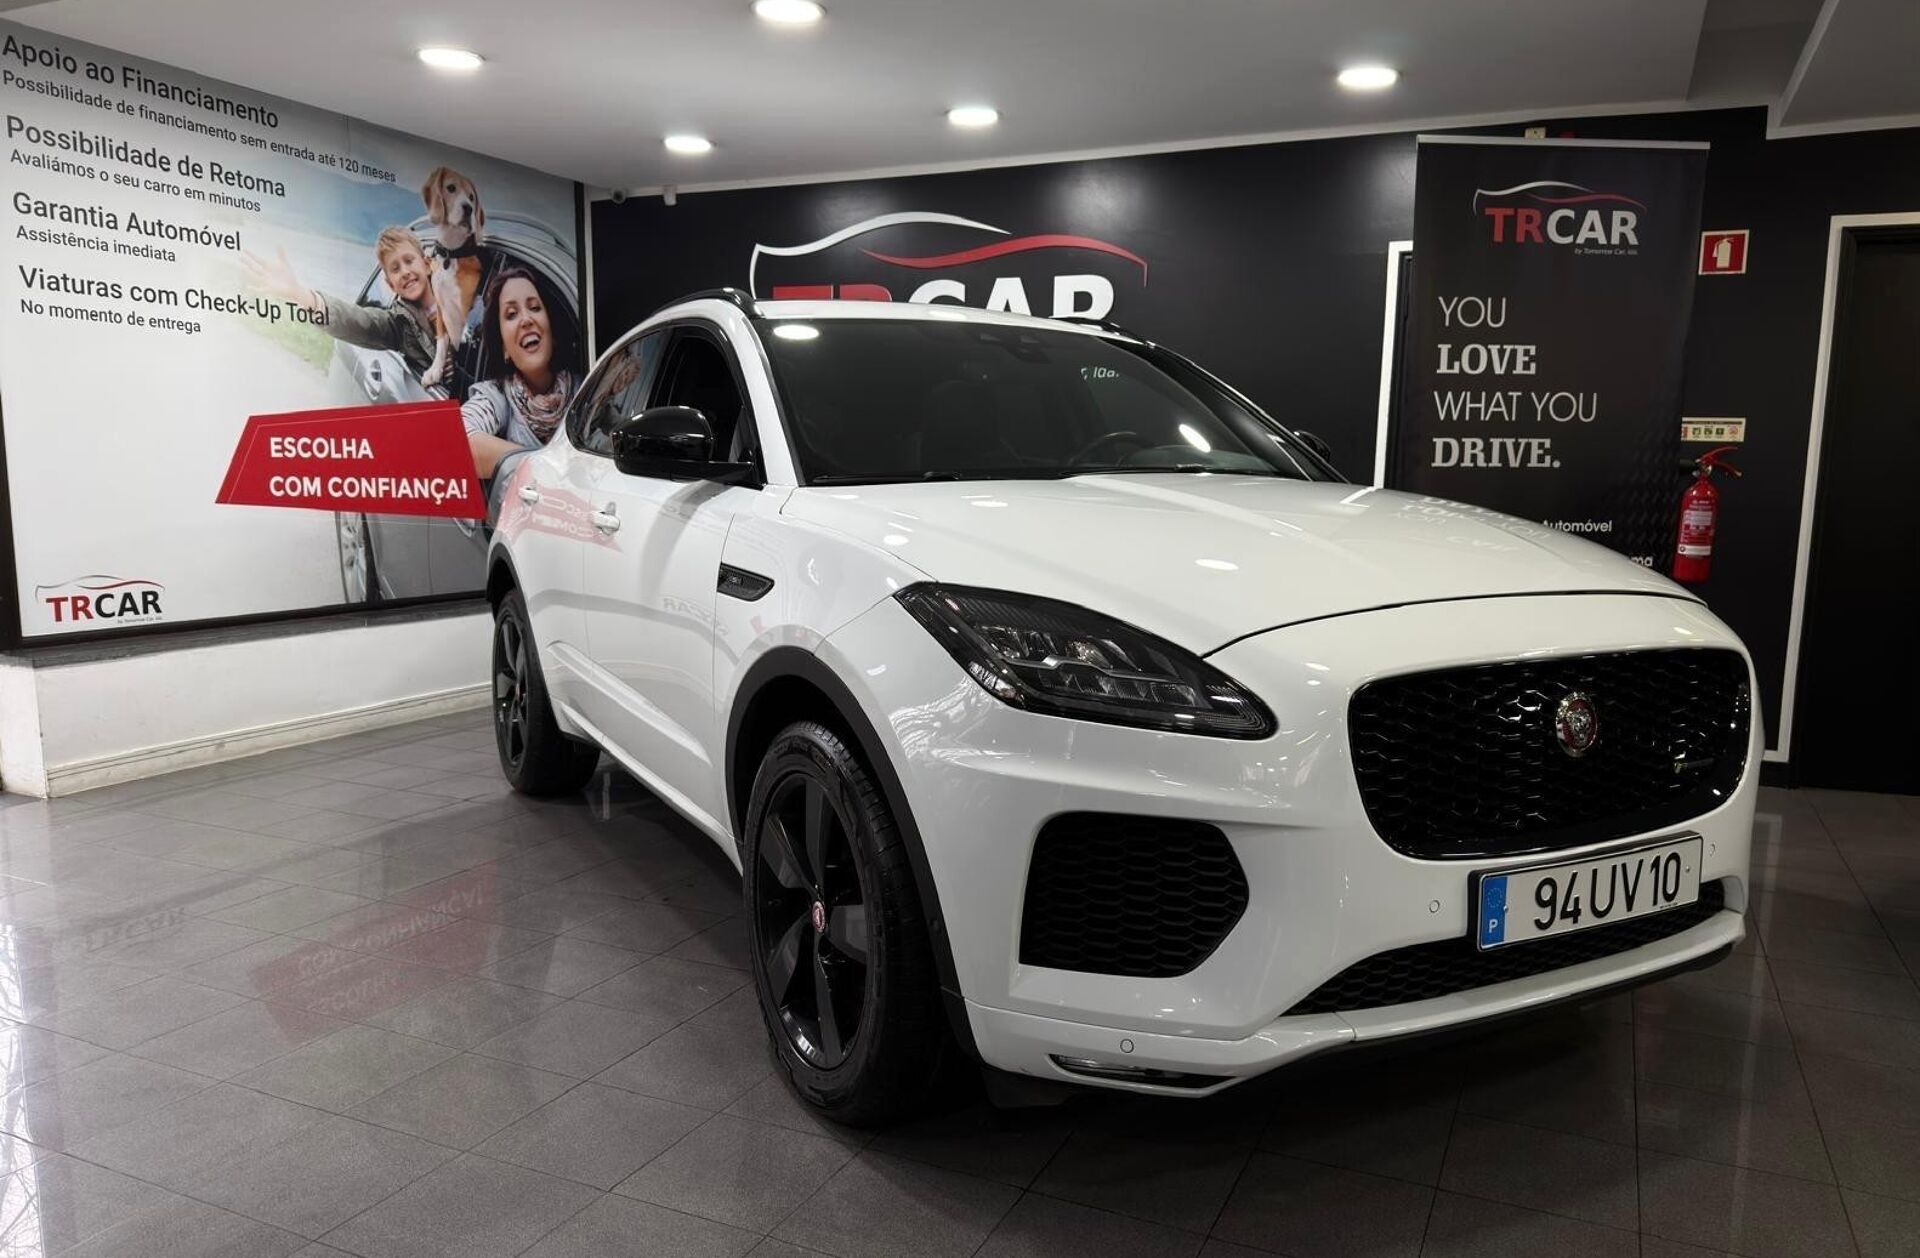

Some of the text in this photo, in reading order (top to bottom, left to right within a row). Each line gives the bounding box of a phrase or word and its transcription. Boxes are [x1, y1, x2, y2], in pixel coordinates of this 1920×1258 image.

[2, 35, 279, 128] Apoio ao Financiamento
[3, 69, 396, 182] Possibilidade de financiamento sem entrada até 120 meses
[6, 115, 286, 197] Possibilidade de Retoma
[11, 149, 261, 212] Avaliámos o seu carro em minutos
[13, 191, 241, 251] Garantia Automóvel
[1485, 207, 1640, 246] TRCAR
[16, 225, 176, 262] Assistência imediata
[19, 265, 330, 326] Viaturas com Check-Up Total
[1438, 296, 1507, 328] YOU
[21, 299, 201, 335] No momento de entrega
[1436, 343, 1536, 375] LOVE
[1433, 391, 1598, 423] WHAT YOU
[269, 436, 374, 459] ESCOLHA
[1431, 437, 1561, 468] DRIVE.
[269, 476, 468, 505] COM CONFIANÇA!
[45, 590, 162, 623] TRCAR
[1488, 918, 1499, 934] P
